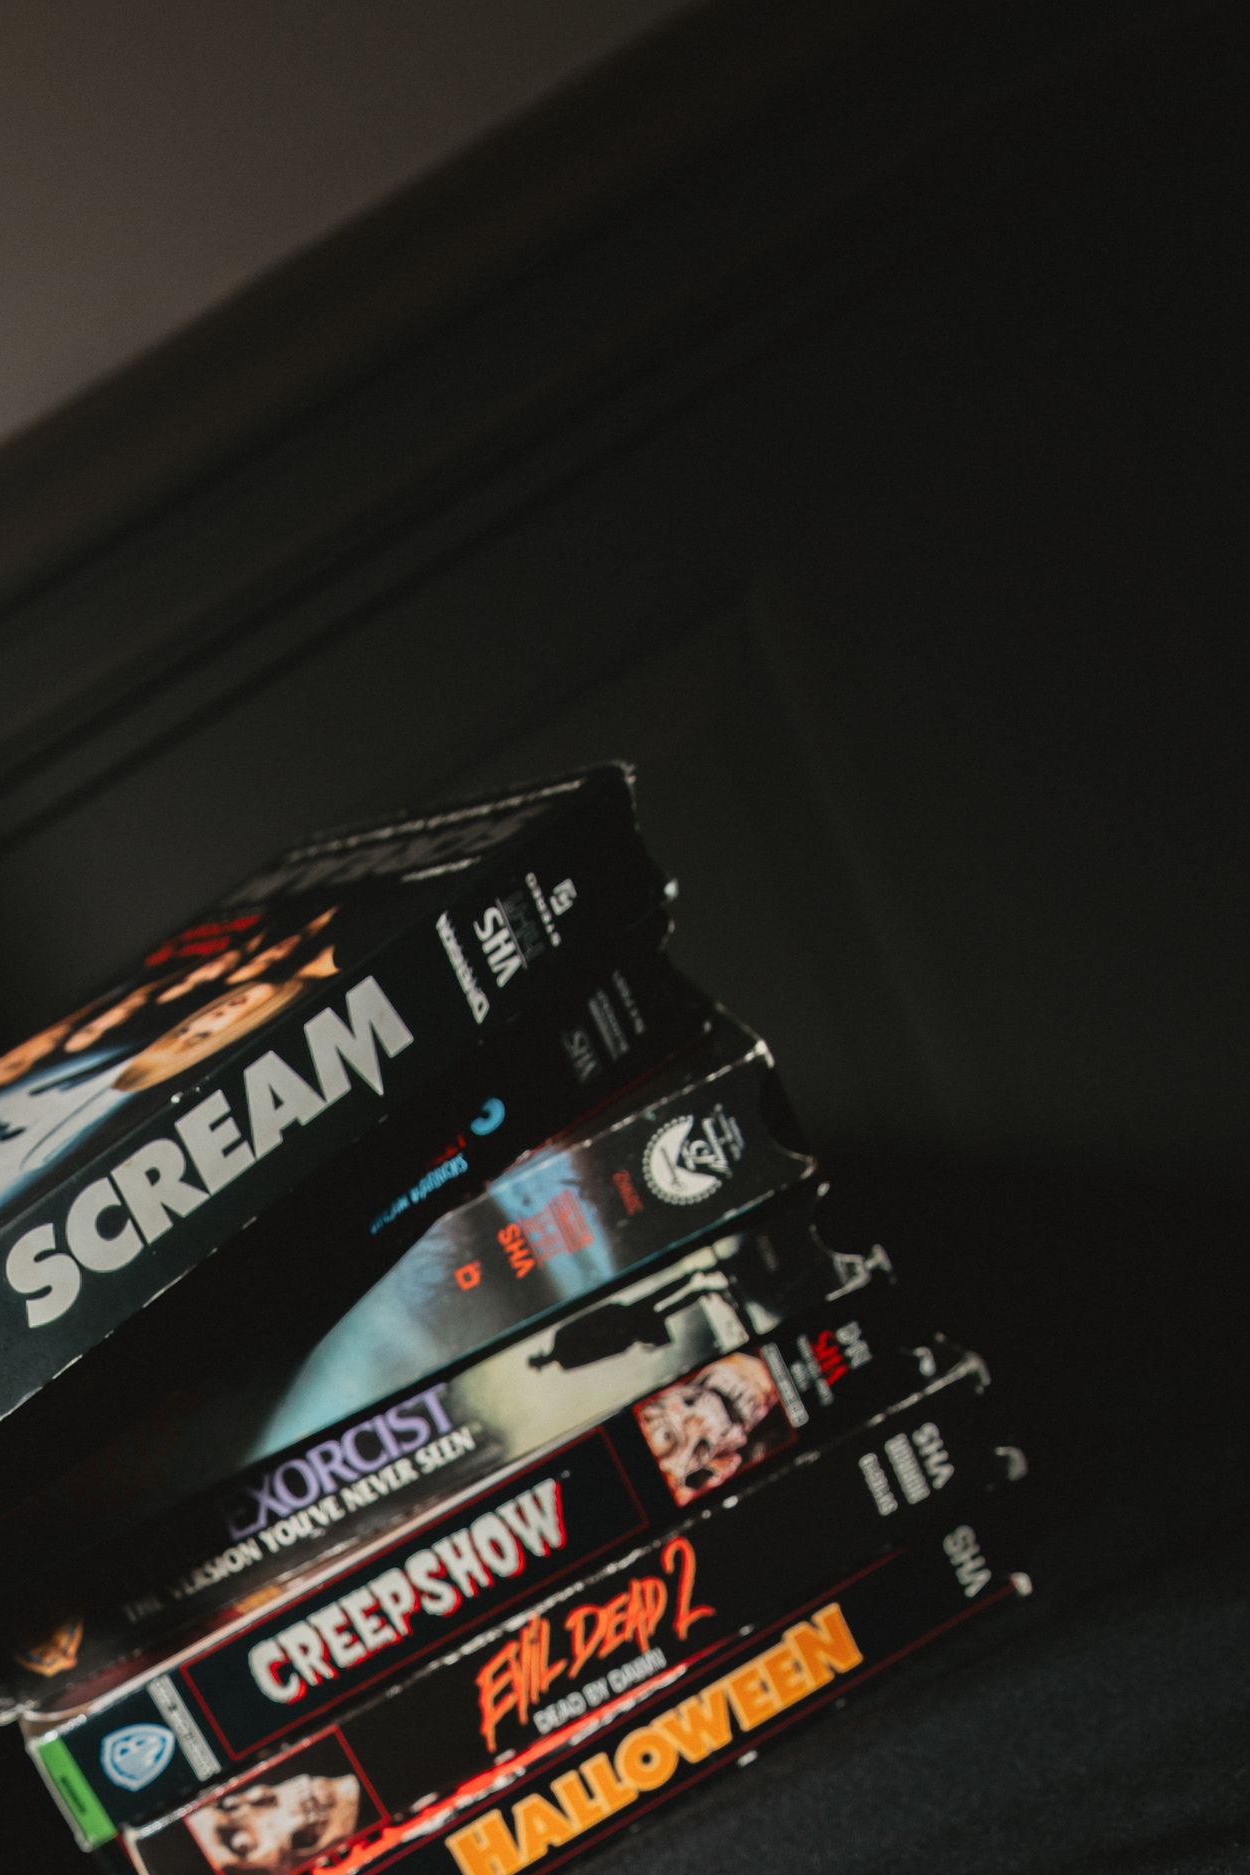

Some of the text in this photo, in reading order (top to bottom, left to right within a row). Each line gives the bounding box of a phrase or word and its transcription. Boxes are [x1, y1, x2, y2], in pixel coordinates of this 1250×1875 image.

[473, 906, 523, 988] VHS
[4, 974, 414, 1328] SCREAM
[498, 1222, 535, 1279] VHS
[229, 1382, 453, 1541] EXORCIST
[259, 1502, 344, 1553] YOU'VE
[338, 1460, 419, 1512] NEVER
[418, 1425, 477, 1474] SEEN
[912, 1422, 955, 1490] VHS
[248, 1477, 568, 1705] CREEPSHOW
[564, 1575, 668, 1679] DEAD
[661, 1536, 715, 1641] 2
[943, 1525, 992, 1598] VHS
[533, 1690, 587, 1735] DEAD
[582, 1678, 610, 1707] BY
